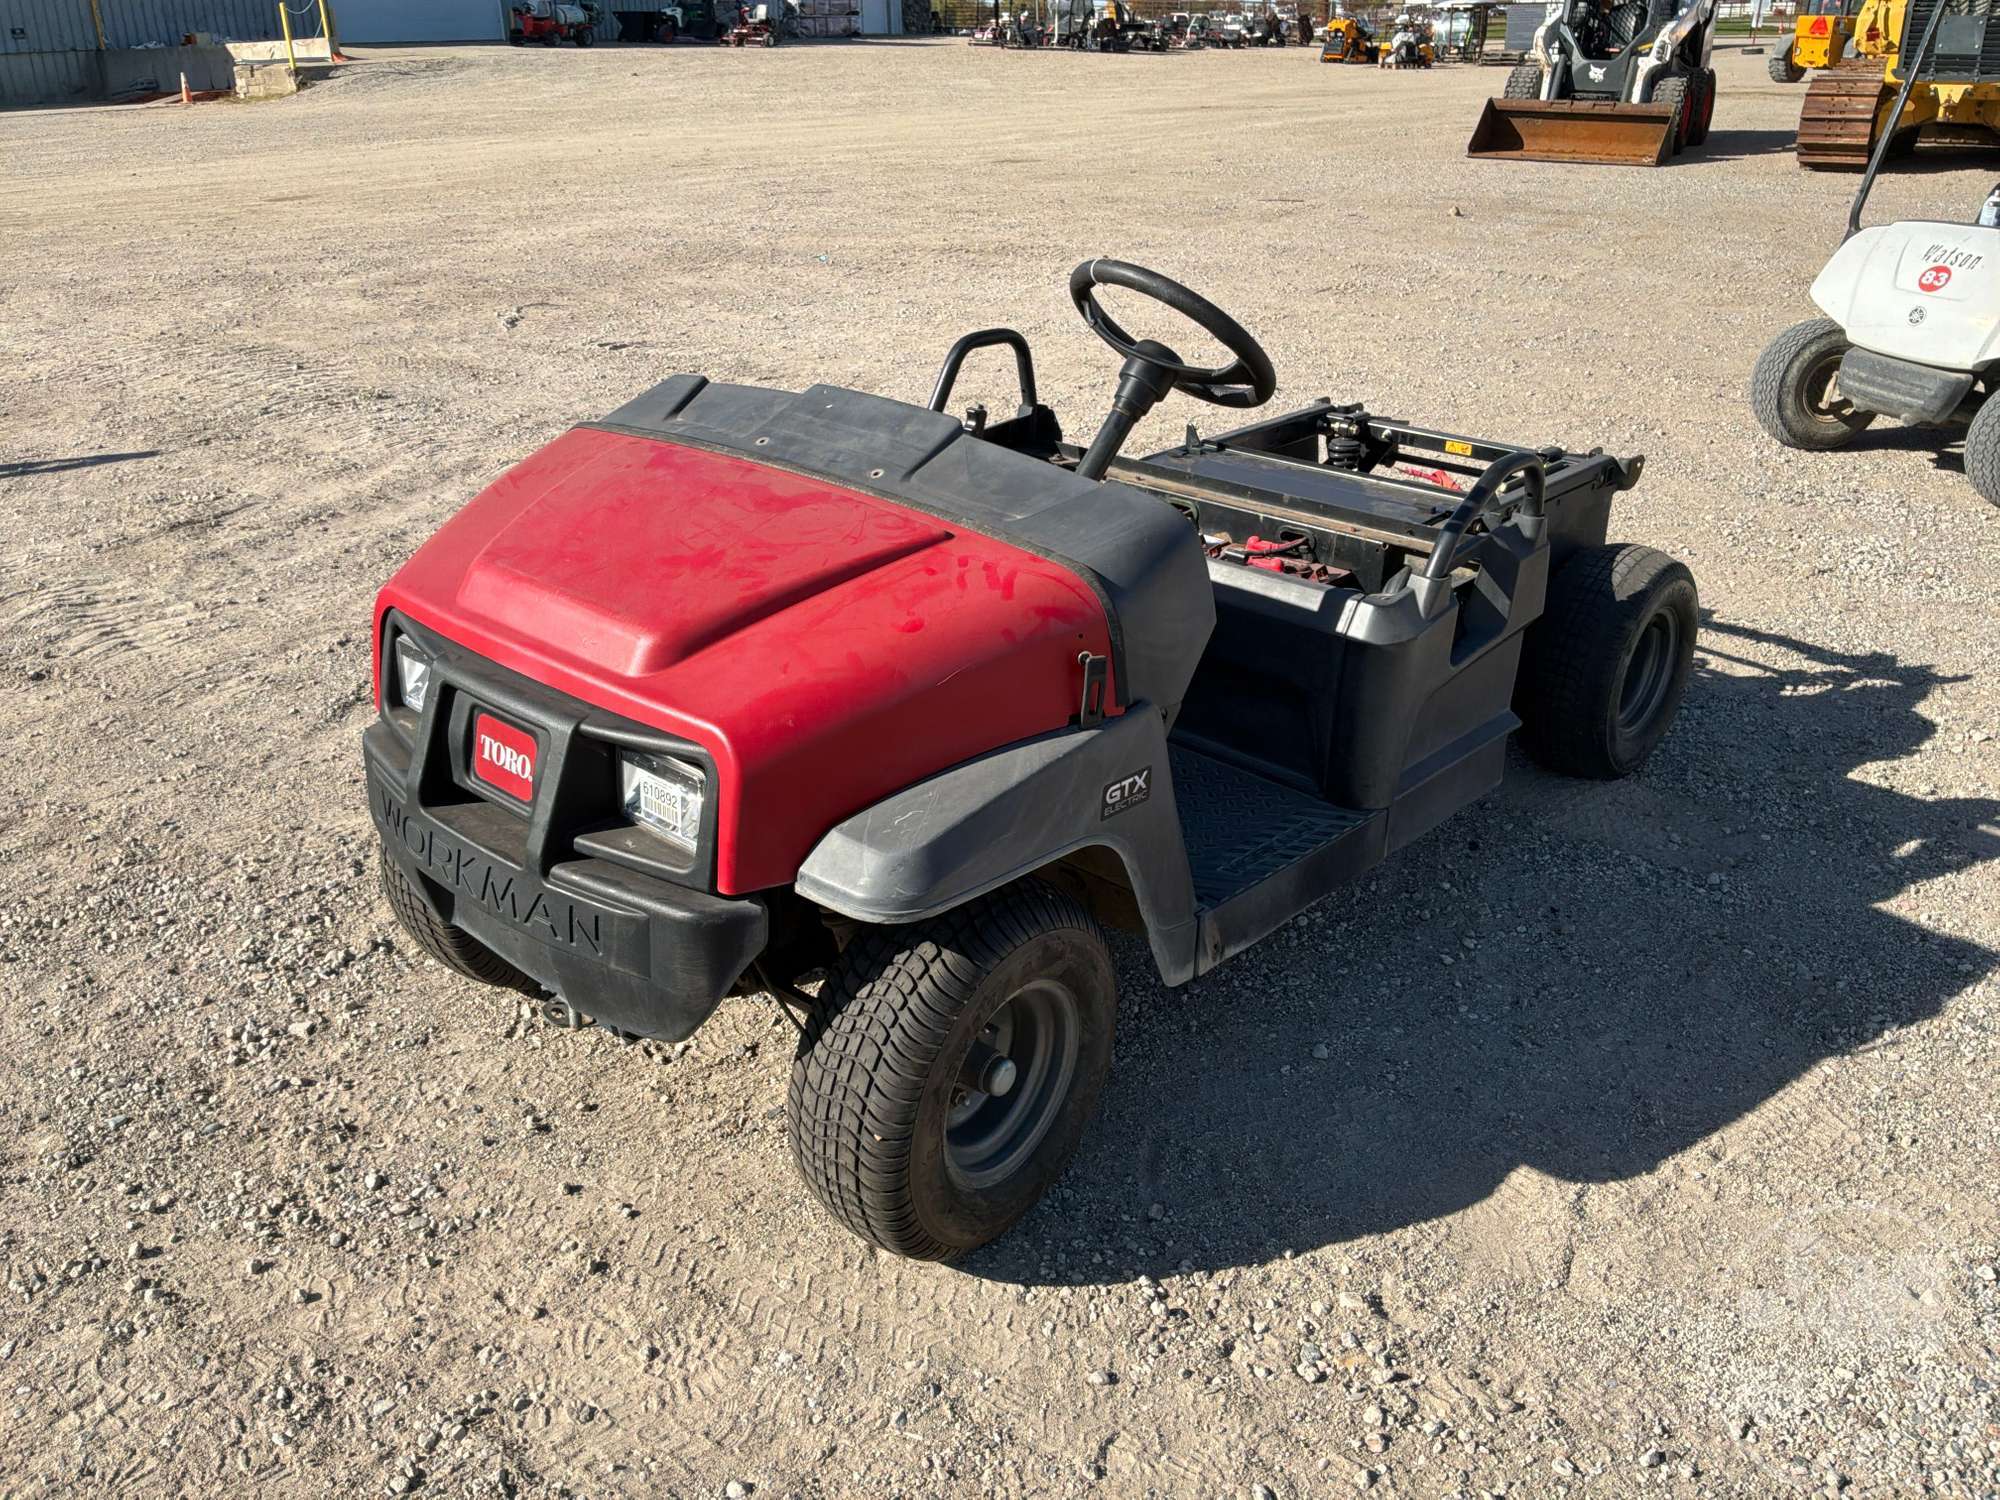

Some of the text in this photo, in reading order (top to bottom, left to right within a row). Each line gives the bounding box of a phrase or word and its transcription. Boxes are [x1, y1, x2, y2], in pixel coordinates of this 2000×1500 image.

[1922, 244, 1983, 270] Watson
[1921, 270, 1949, 287] 83
[643, 781, 678, 809] 610892
[1106, 769, 1148, 804] GTX
[381, 789, 603, 957] WORKMAN
